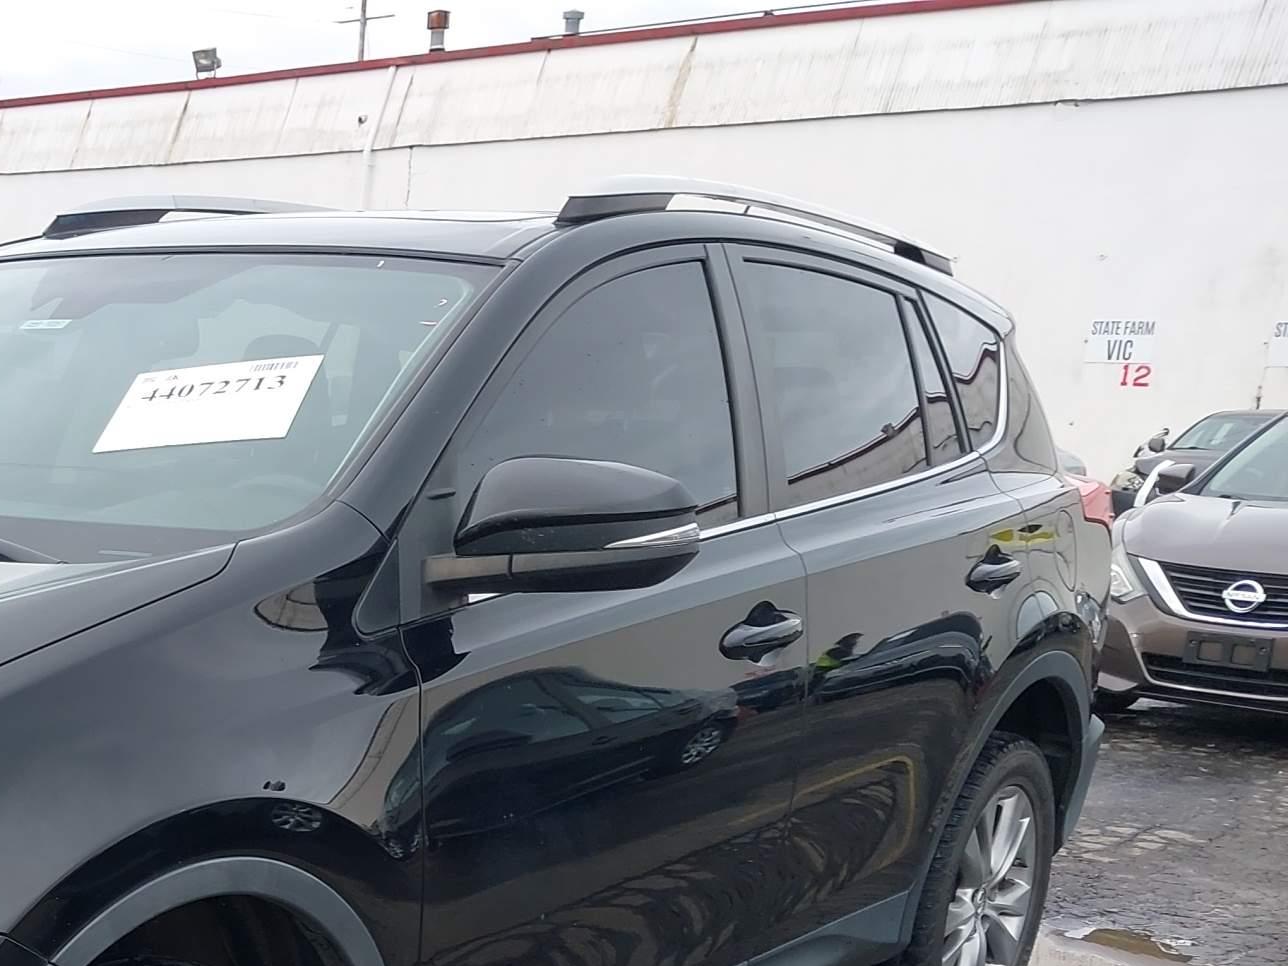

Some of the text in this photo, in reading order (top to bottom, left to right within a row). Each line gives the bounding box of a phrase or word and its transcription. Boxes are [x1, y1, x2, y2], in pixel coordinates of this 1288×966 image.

[1091, 320, 1155, 336] STATE FARM
[1107, 339, 1134, 361] VIC
[1120, 364, 1151, 387] 12
[141, 374, 288, 402] 44072713
